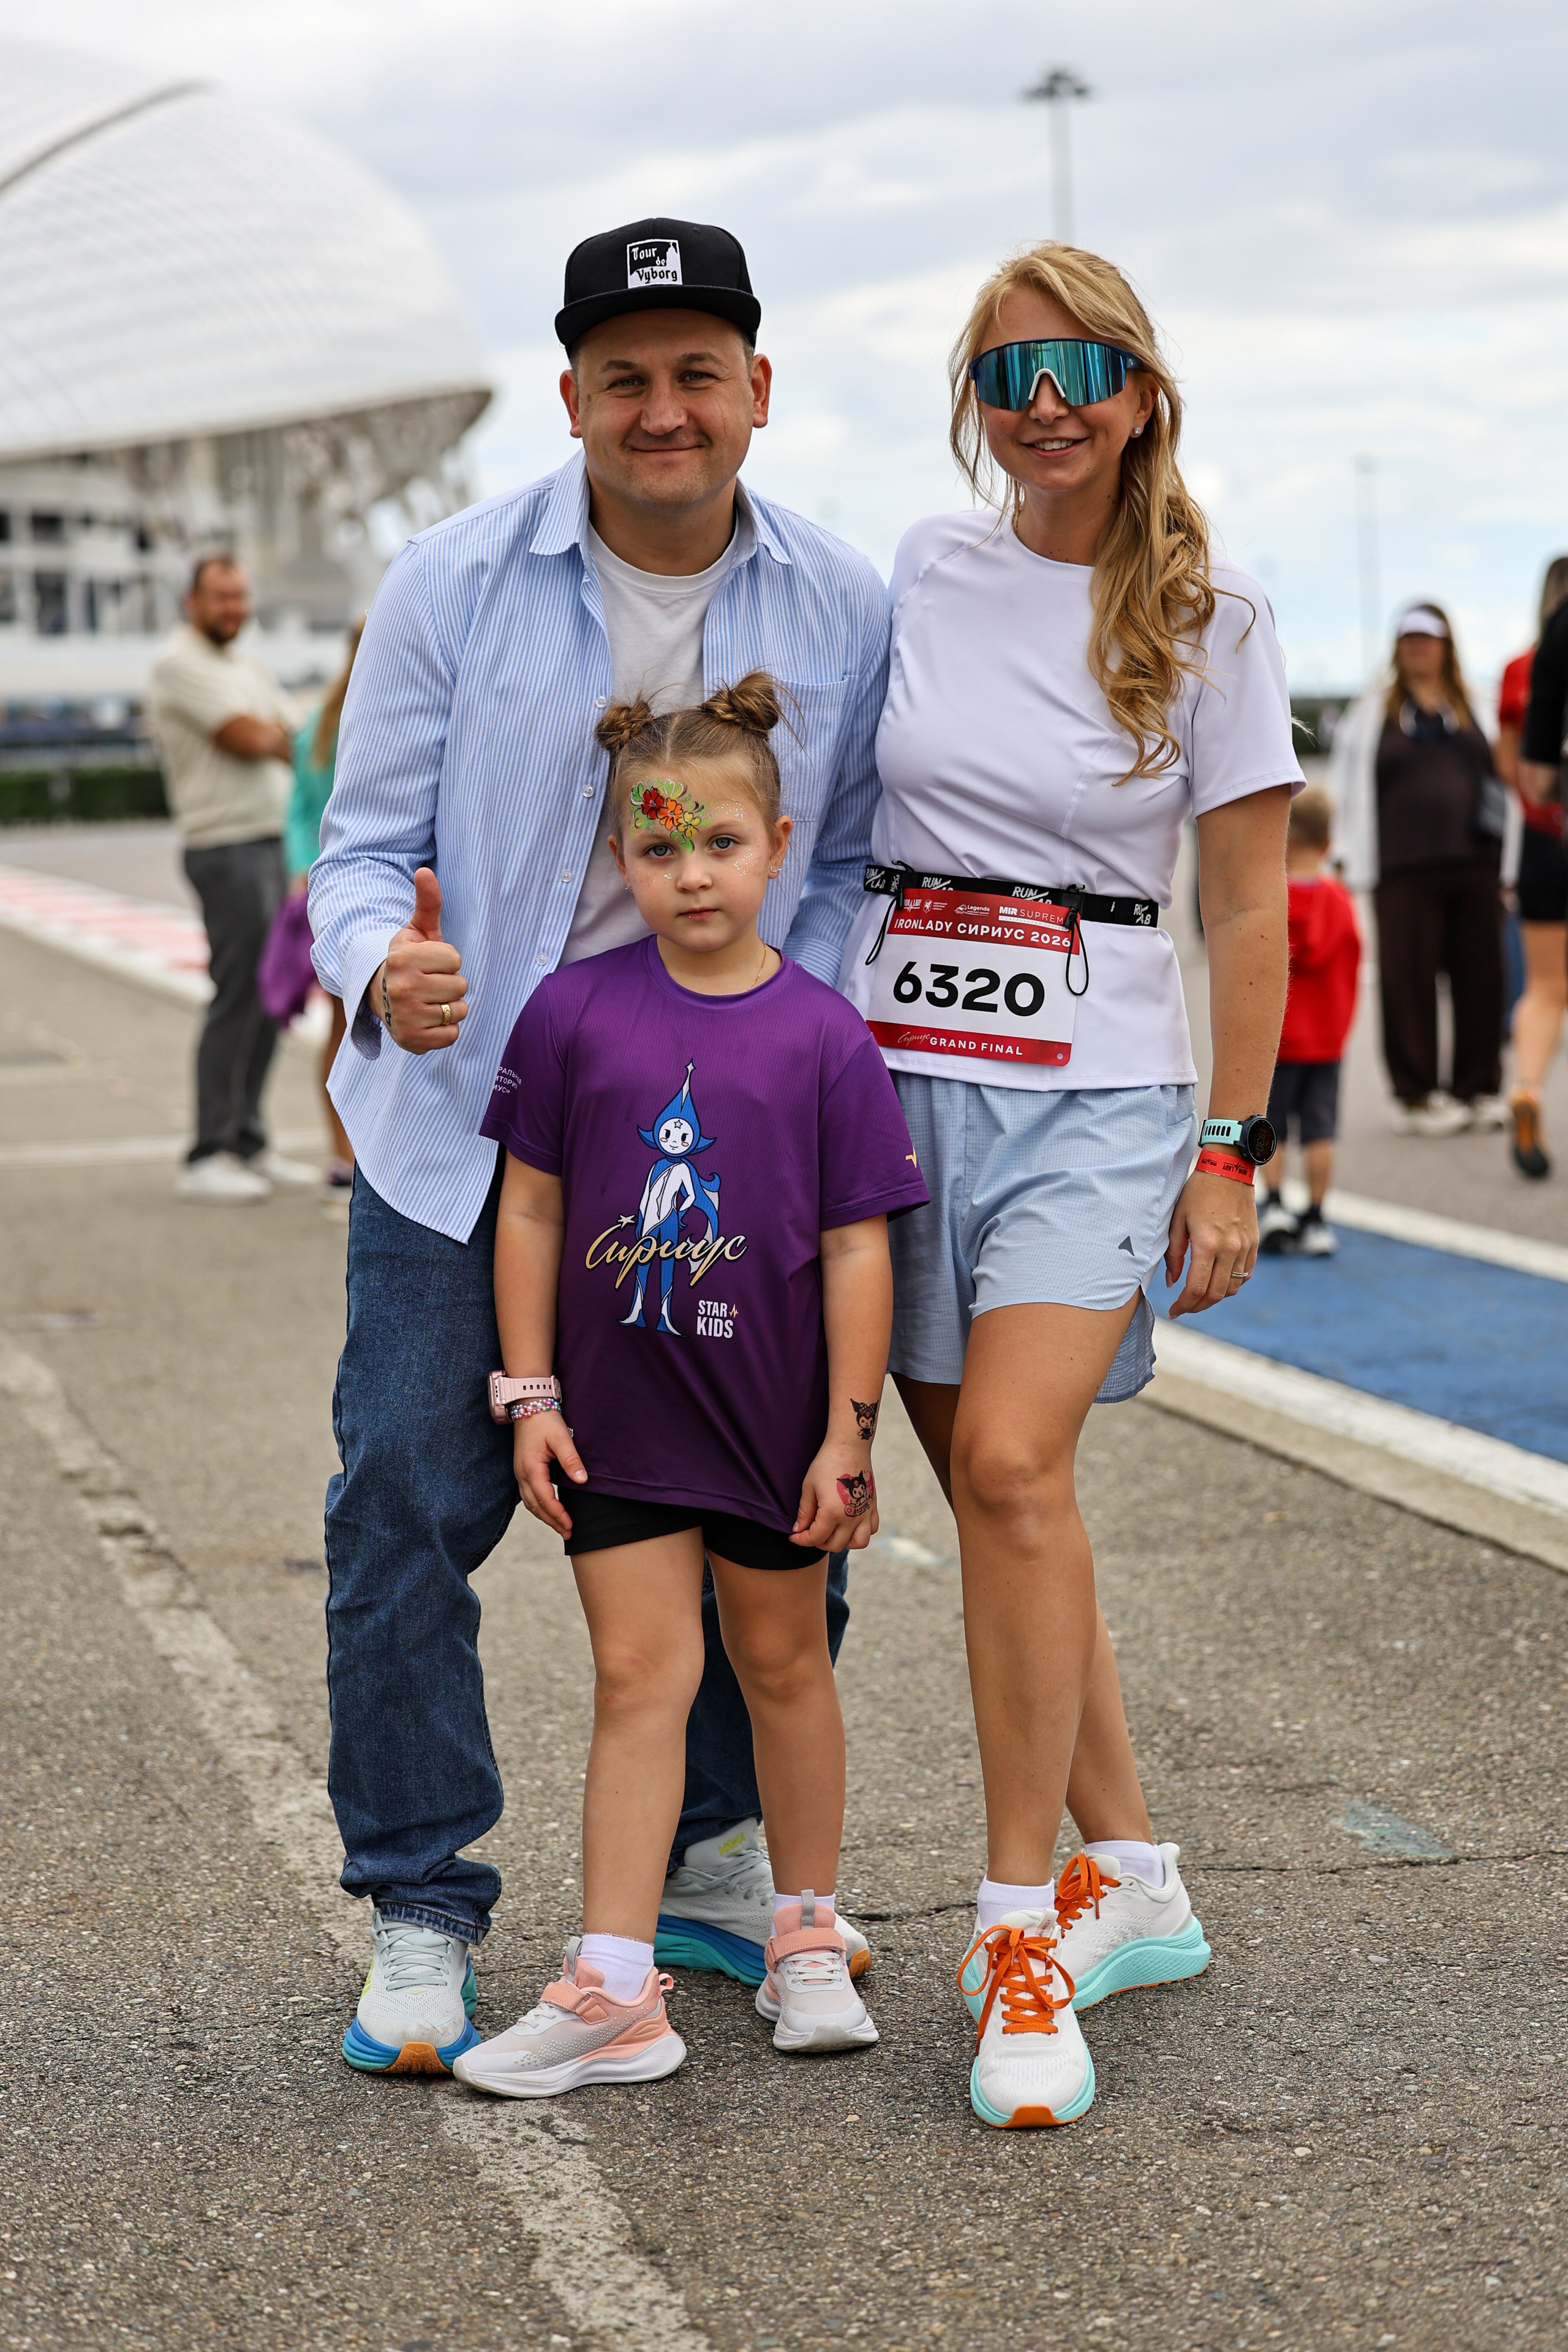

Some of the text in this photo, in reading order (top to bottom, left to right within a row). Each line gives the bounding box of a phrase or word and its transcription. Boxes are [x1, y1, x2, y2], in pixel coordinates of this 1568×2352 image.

[631, 247, 657, 261] Tour
[655, 256, 665, 266] de
[636, 267, 677, 284] Vyborg
[921, 876, 942, 888] RUN
[1012, 886, 1038, 899] RUN
[999, 906, 1064, 924] MIR SUPREM
[894, 918, 1071, 948] IRONLADY СИРИУС 2026
[893, 961, 1045, 1017] 6320
[929, 1036, 1023, 1056] GRAND FINAL
[1222, 1164, 1234, 1172] LADY
[698, 1300, 728, 1317] STAR
[696, 1316, 734, 1339] KIDS
